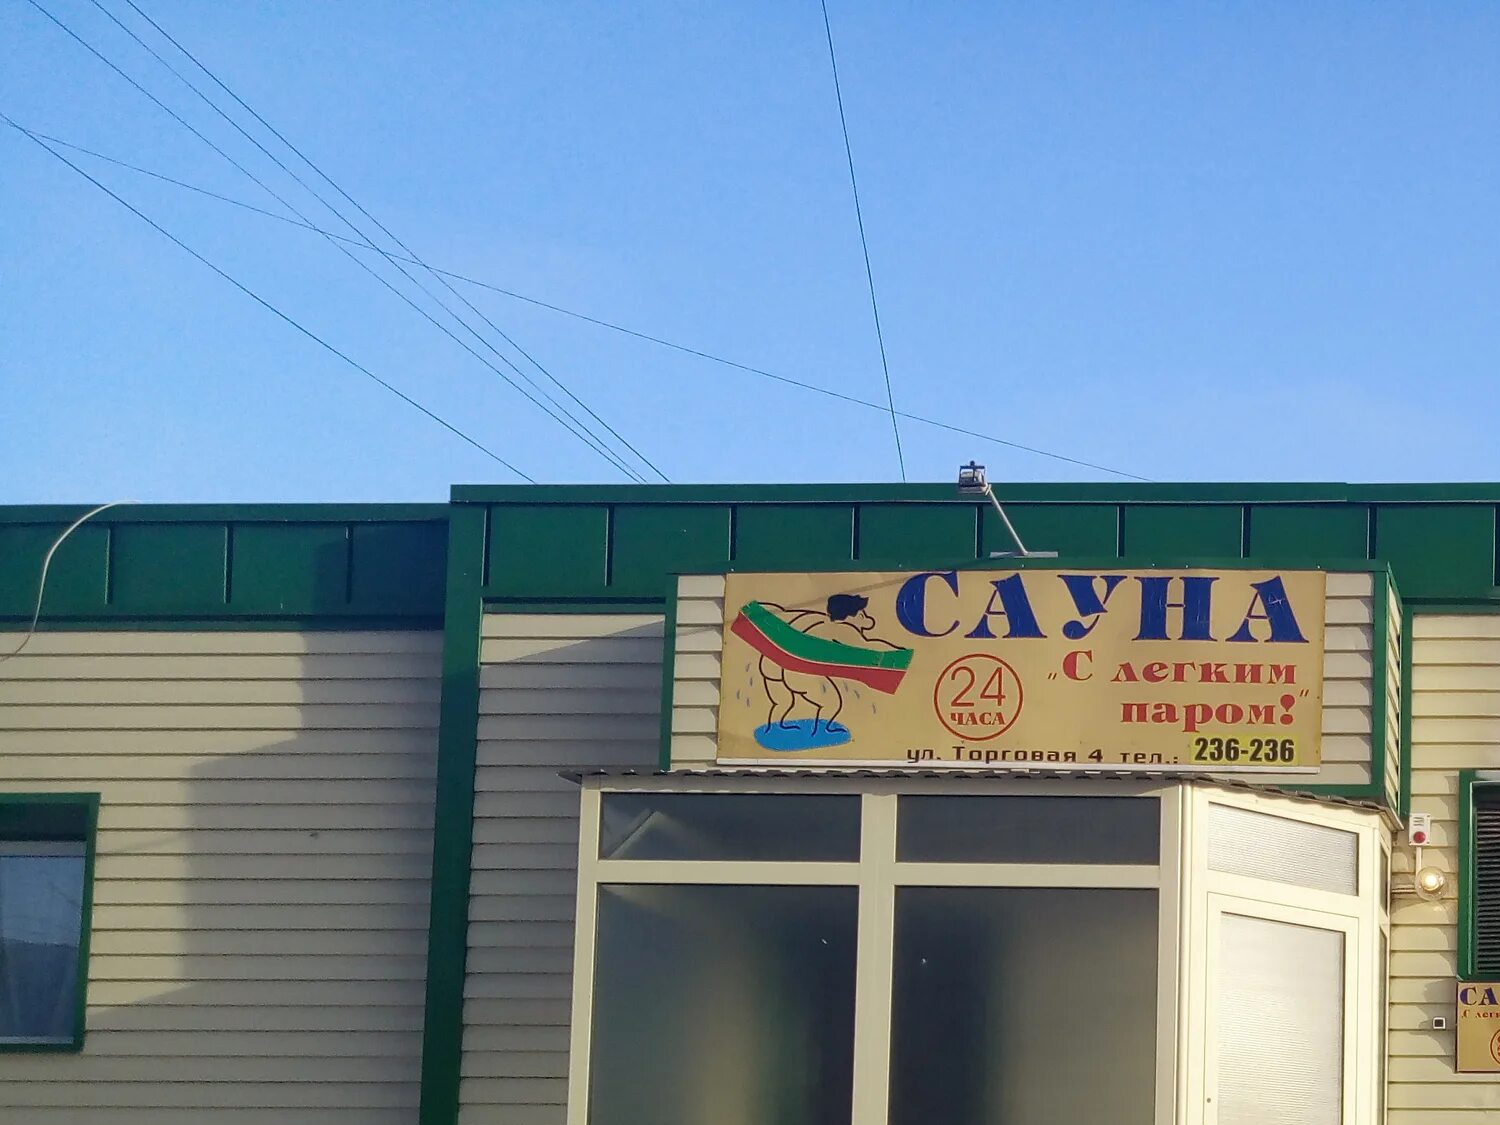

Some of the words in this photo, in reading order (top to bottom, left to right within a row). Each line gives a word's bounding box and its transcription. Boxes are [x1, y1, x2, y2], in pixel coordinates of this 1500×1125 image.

[896, 571, 1309, 643] САУНА
[951, 666, 1006, 707] 24
[1110, 662, 1297, 684] легким
[951, 712, 1005, 725] ЧАСА
[907, 749, 941, 763] ул.
[952, 746, 1076, 764] Торговая
[1088, 749, 1103, 762] 4
[1120, 752, 1179, 764] тел.:
[1194, 737, 1295, 762] 236-236
